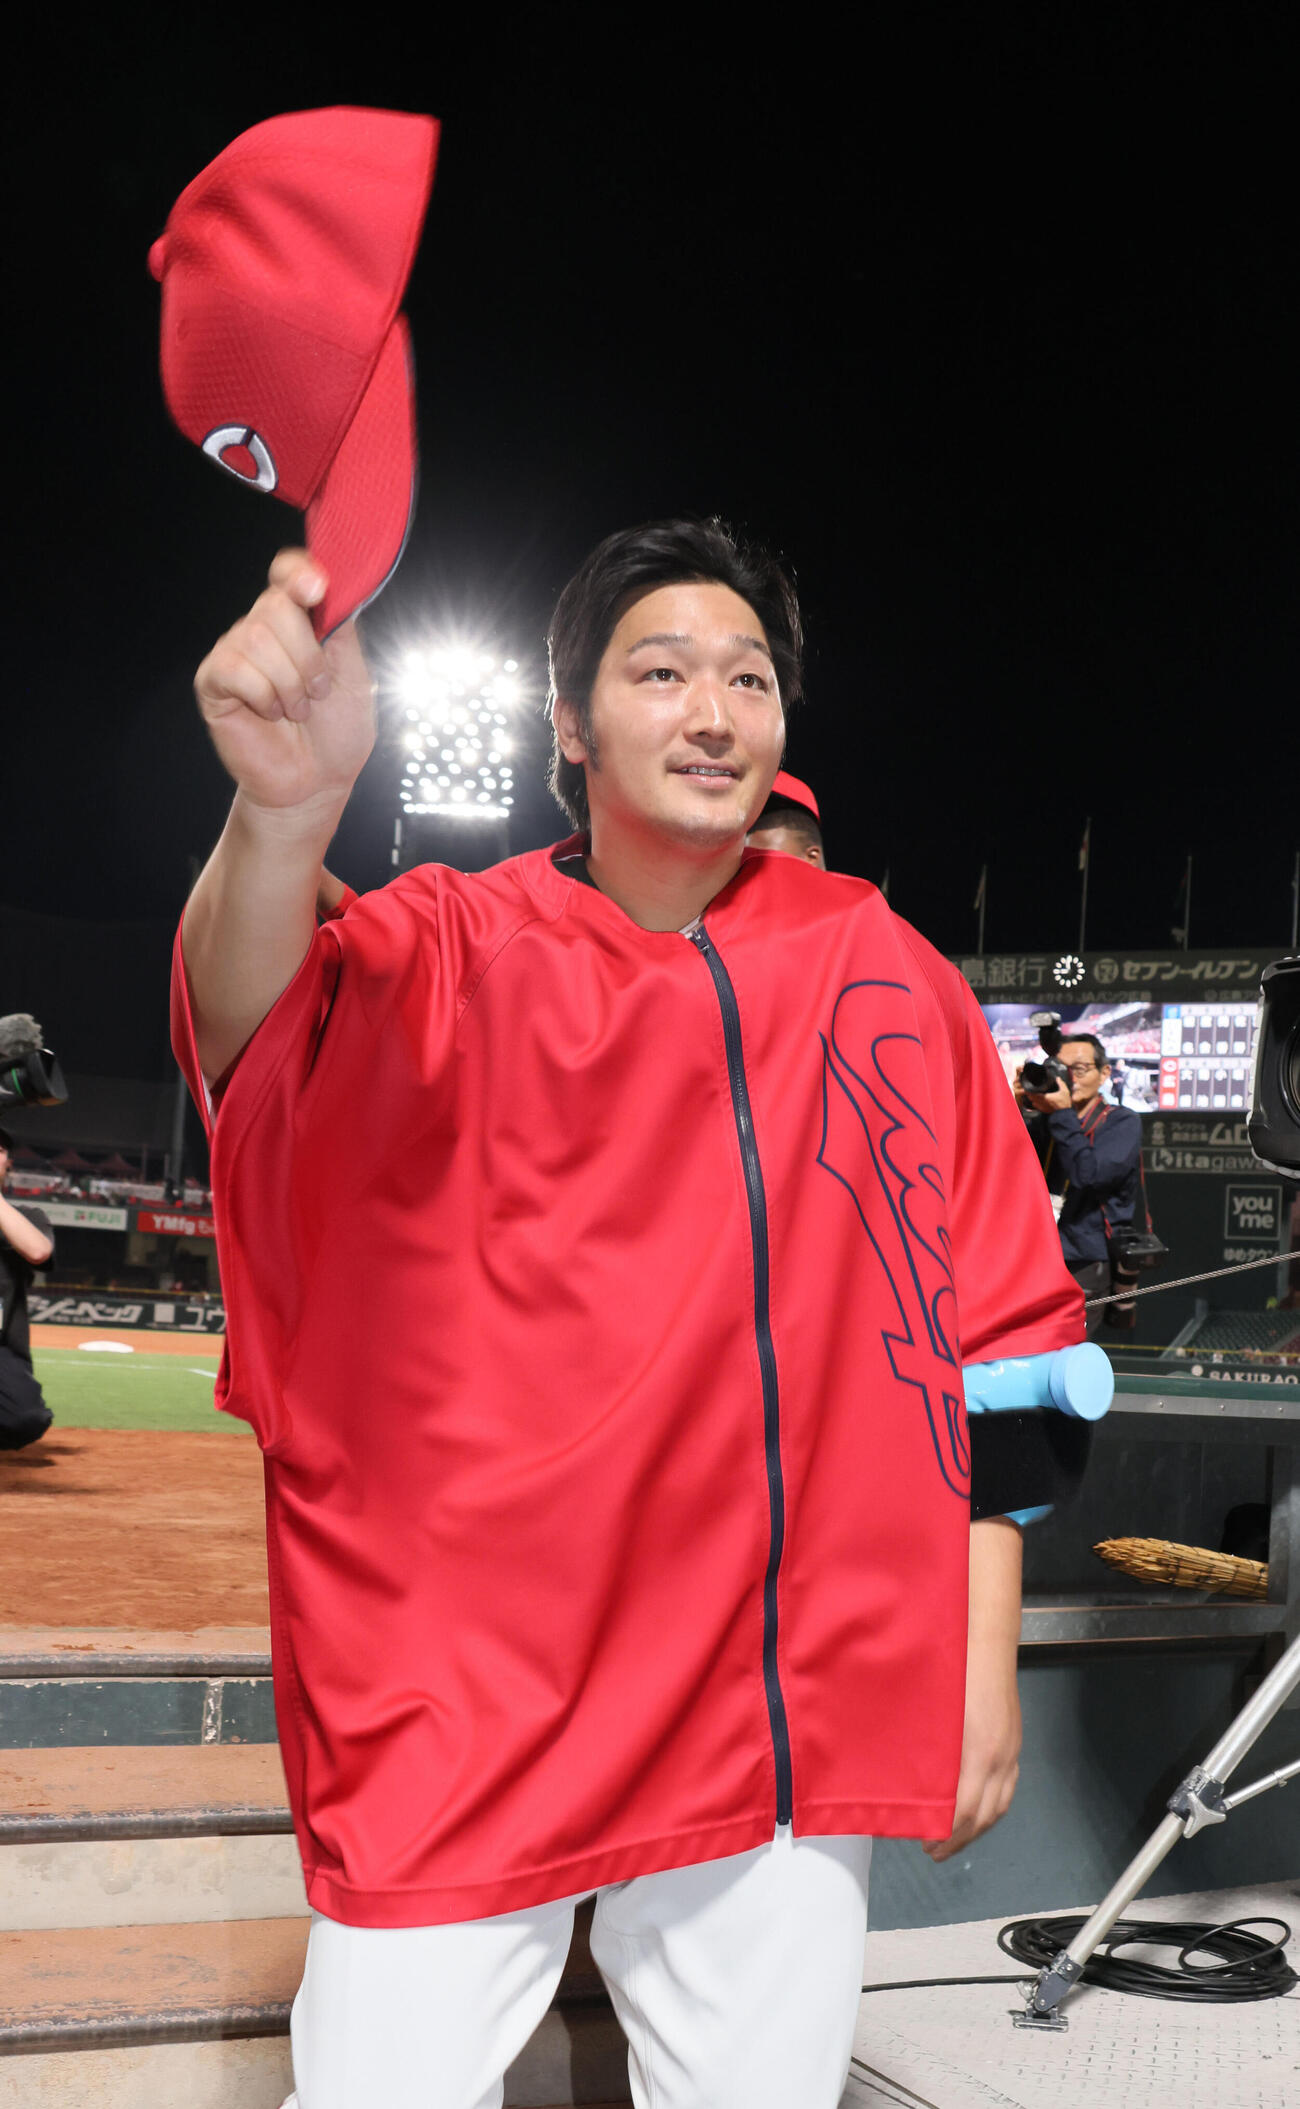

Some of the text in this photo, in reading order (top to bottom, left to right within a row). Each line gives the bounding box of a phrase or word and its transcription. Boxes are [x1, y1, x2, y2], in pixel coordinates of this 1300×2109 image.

[954, 958, 1048, 987] 島銀行
[1232, 1196, 1273, 1215] you
[1240, 1213, 1274, 1229] me
